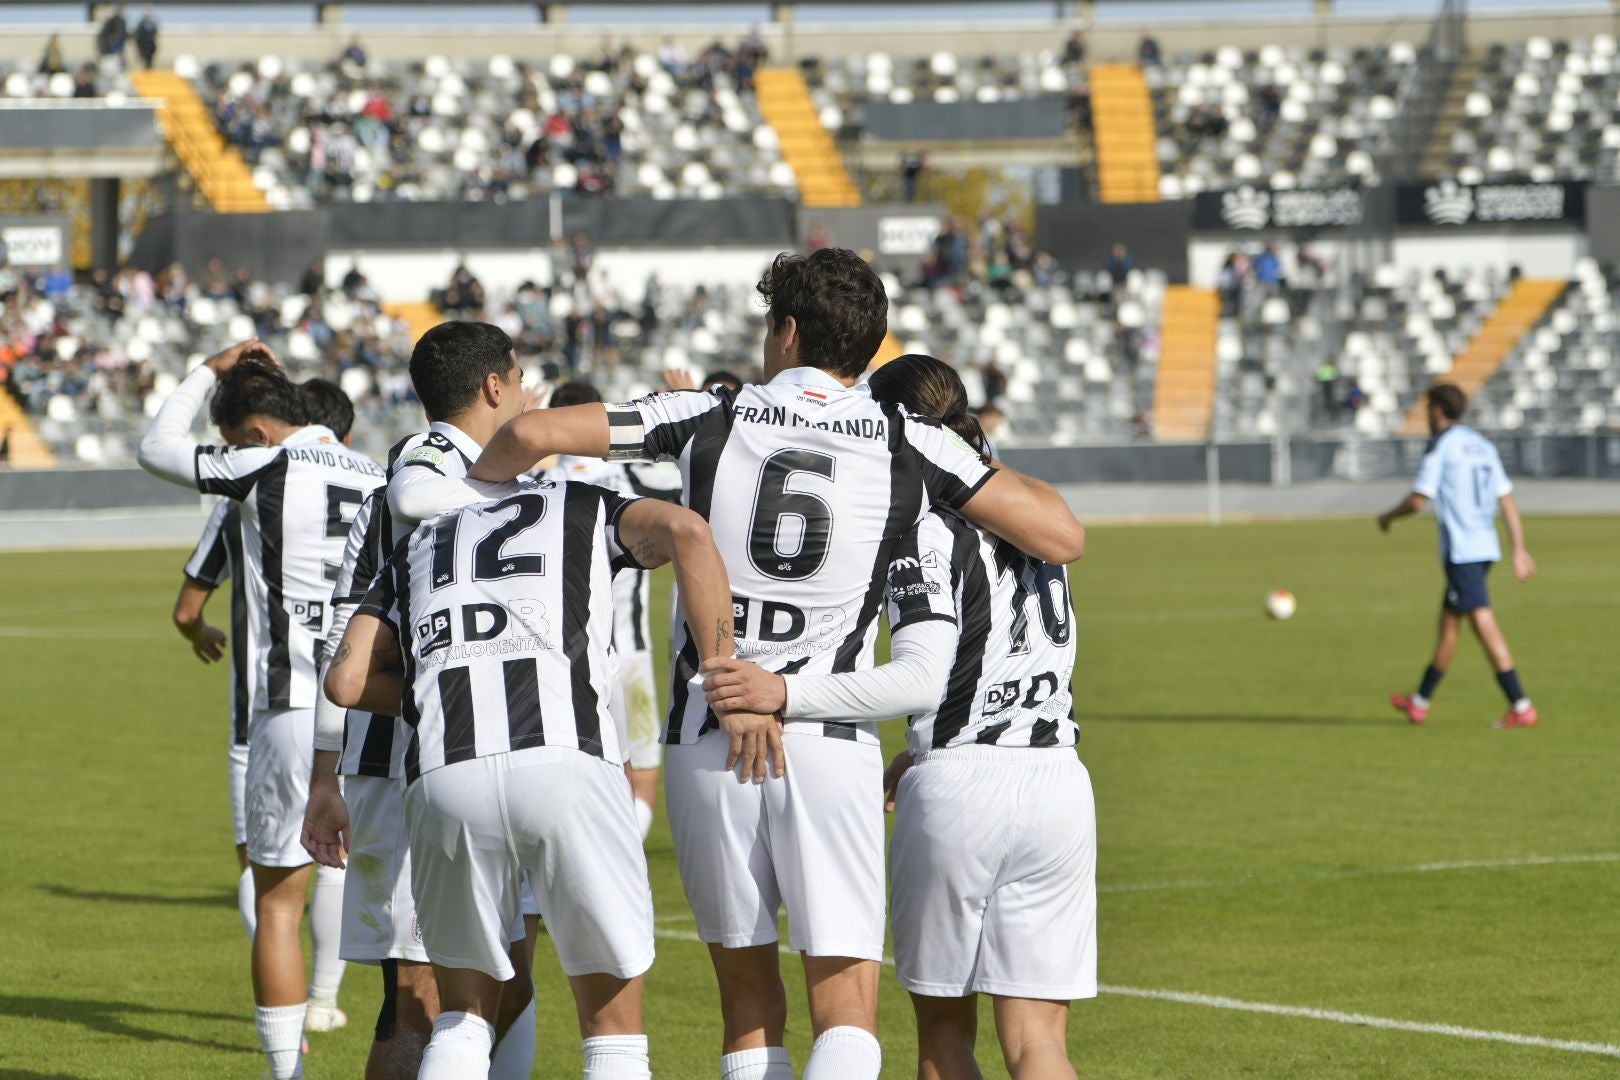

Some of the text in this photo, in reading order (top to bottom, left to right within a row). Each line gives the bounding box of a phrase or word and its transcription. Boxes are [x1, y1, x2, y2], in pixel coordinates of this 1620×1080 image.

[733, 404, 787, 427] FRAN
[288, 448, 336, 467] DAVID
[747, 446, 837, 582] 6
[430, 493, 548, 593] 12
[295, 604, 321, 618] DB
[733, 603, 745, 618] B
[418, 616, 448, 638] DB
[420, 635, 555, 673] MAXILODENTAL
[733, 638, 835, 656] XILODENT
